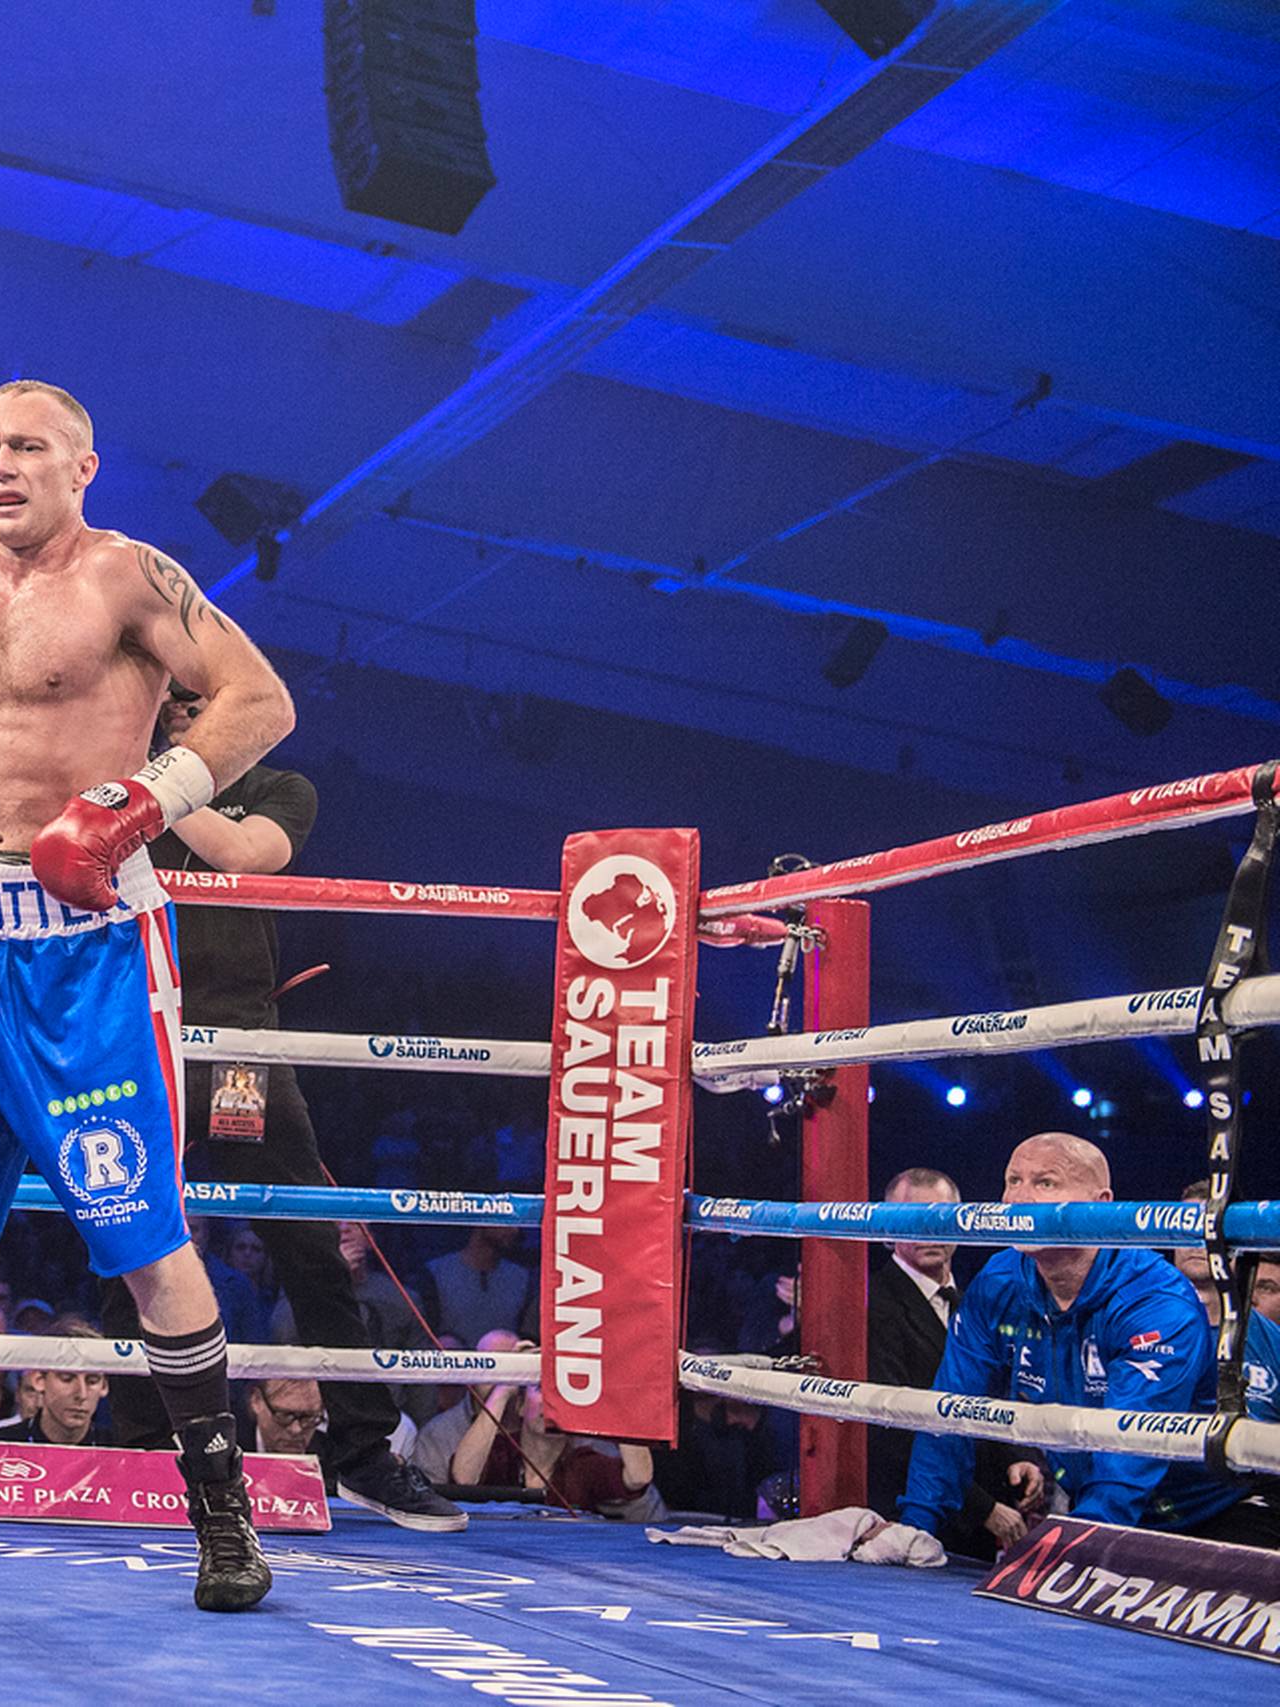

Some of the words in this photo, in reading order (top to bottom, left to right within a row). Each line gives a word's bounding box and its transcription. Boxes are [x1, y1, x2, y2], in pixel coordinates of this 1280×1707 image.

[1147, 774, 1212, 800] VIASAT
[160, 870, 241, 890] VIASAT
[417, 886, 510, 904] SAUERLAND
[1146, 989, 1202, 1011] VIASA
[395, 1045, 491, 1061] SAUERLAND
[611, 977, 669, 1183] TEAM
[80, 1128, 130, 1191] R
[184, 1185, 240, 1201] ASAT
[555, 975, 615, 1407] SAUERLAND
[75, 1199, 149, 1220] DIADORA
[418, 1199, 515, 1215] SAUERLAND
[1153, 1207, 1206, 1231] VIASA
[1204, 1091, 1237, 1436] SAUERLAD
[401, 1353, 496, 1369] SAUERLAND
[952, 1404, 1016, 1426] SAUERLAND
[1135, 1413, 1209, 1437] VIASAT
[35, 1489, 111, 1505] PLAZA
